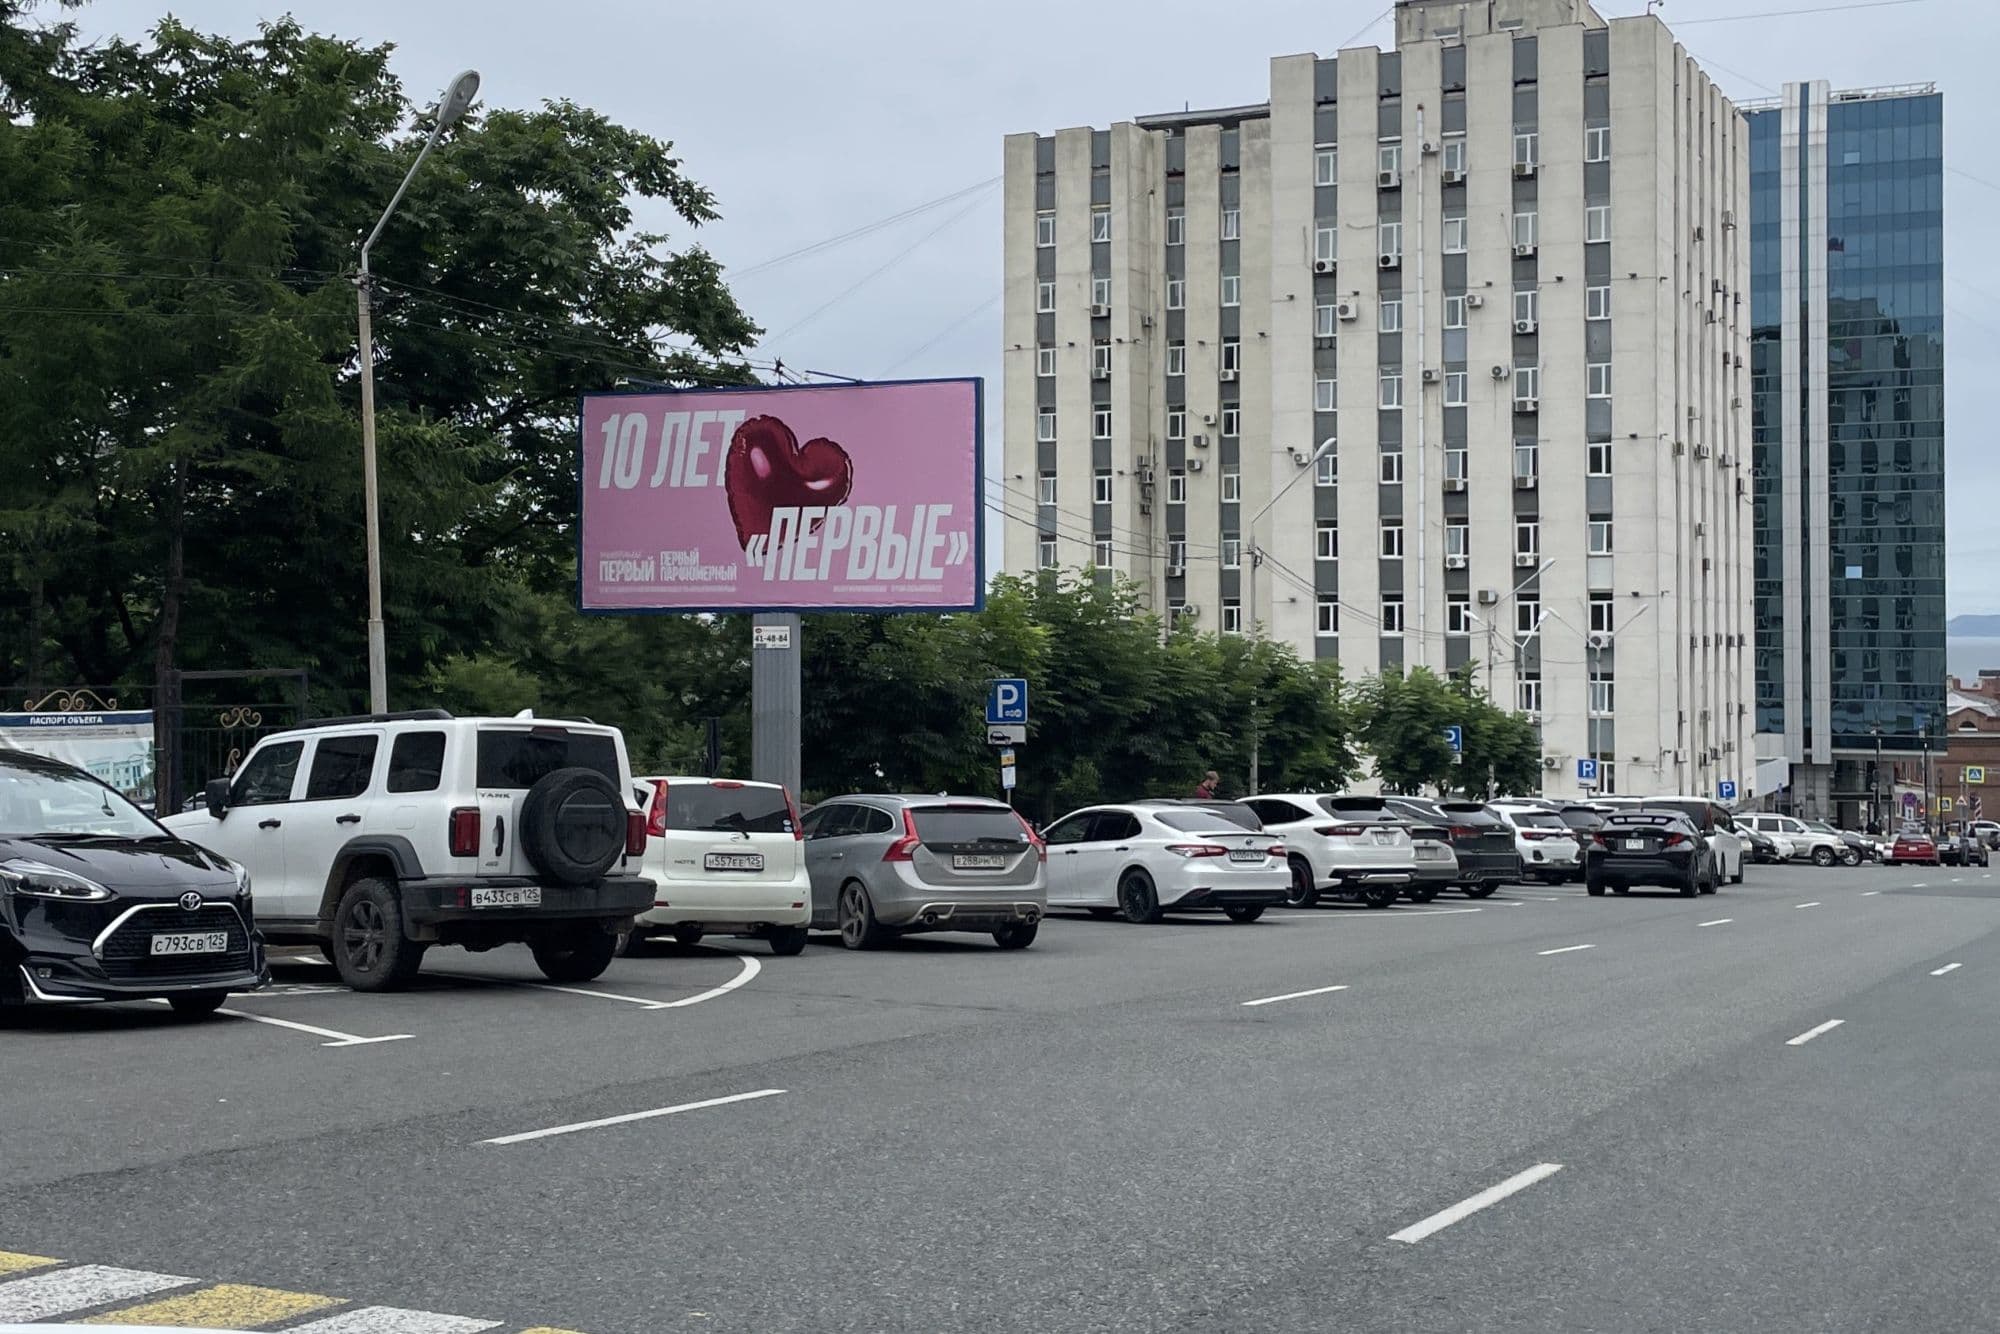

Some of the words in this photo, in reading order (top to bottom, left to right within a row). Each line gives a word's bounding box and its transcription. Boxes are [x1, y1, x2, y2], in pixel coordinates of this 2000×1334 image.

[599, 412, 648, 489] 10
[650, 409, 746, 488] ЛЕТ
[600, 555, 655, 582] ПЕРВЫЙ
[745, 504, 969, 581] «ПЕРВЫЕ»
[997, 684, 1018, 718] P
